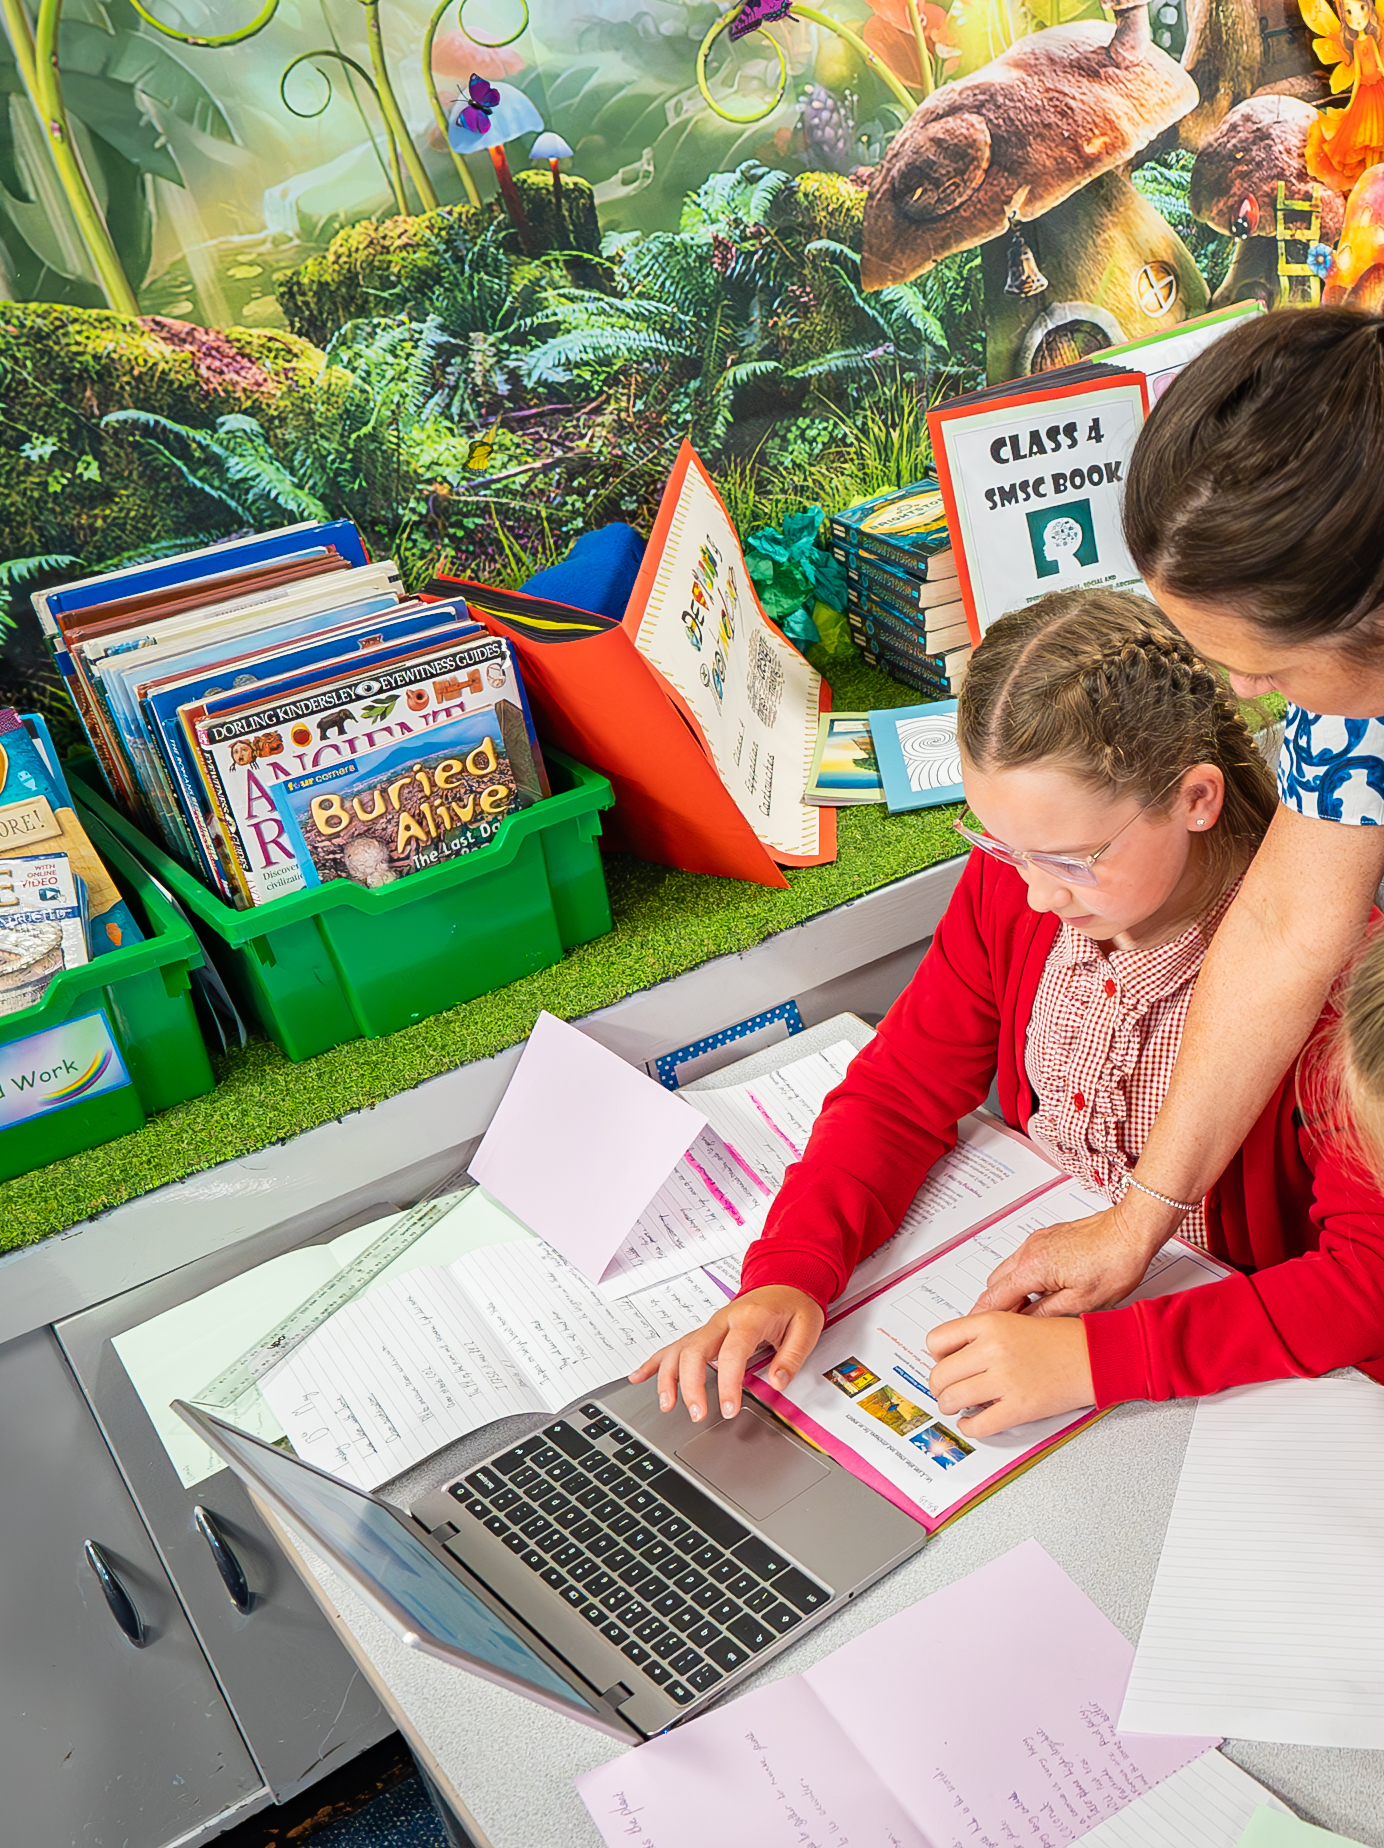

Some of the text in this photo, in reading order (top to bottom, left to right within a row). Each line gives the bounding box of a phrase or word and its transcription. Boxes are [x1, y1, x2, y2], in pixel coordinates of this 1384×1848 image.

[990, 417, 1105, 464] CLASS 4
[984, 461, 1123, 511] SMSC BOOK
[213, 644, 501, 741] DORLING KINDERSLEY EYEWITNESS GUIDES
[311, 737, 498, 837] Buried
[315, 765, 355, 784] corners
[759, 752, 776, 817] Cartouches
[398, 784, 509, 853] Alive
[35, 863, 56, 872] WITH
[412, 853, 439, 869] The
[442, 832, 476, 856] Last
[480, 822, 501, 838] Da
[21, 876, 58, 889] VIDEO
[27, 868, 57, 880] ONLINE
[10, 1059, 79, 1092] Work
[620, 1816, 643, 1839] the
